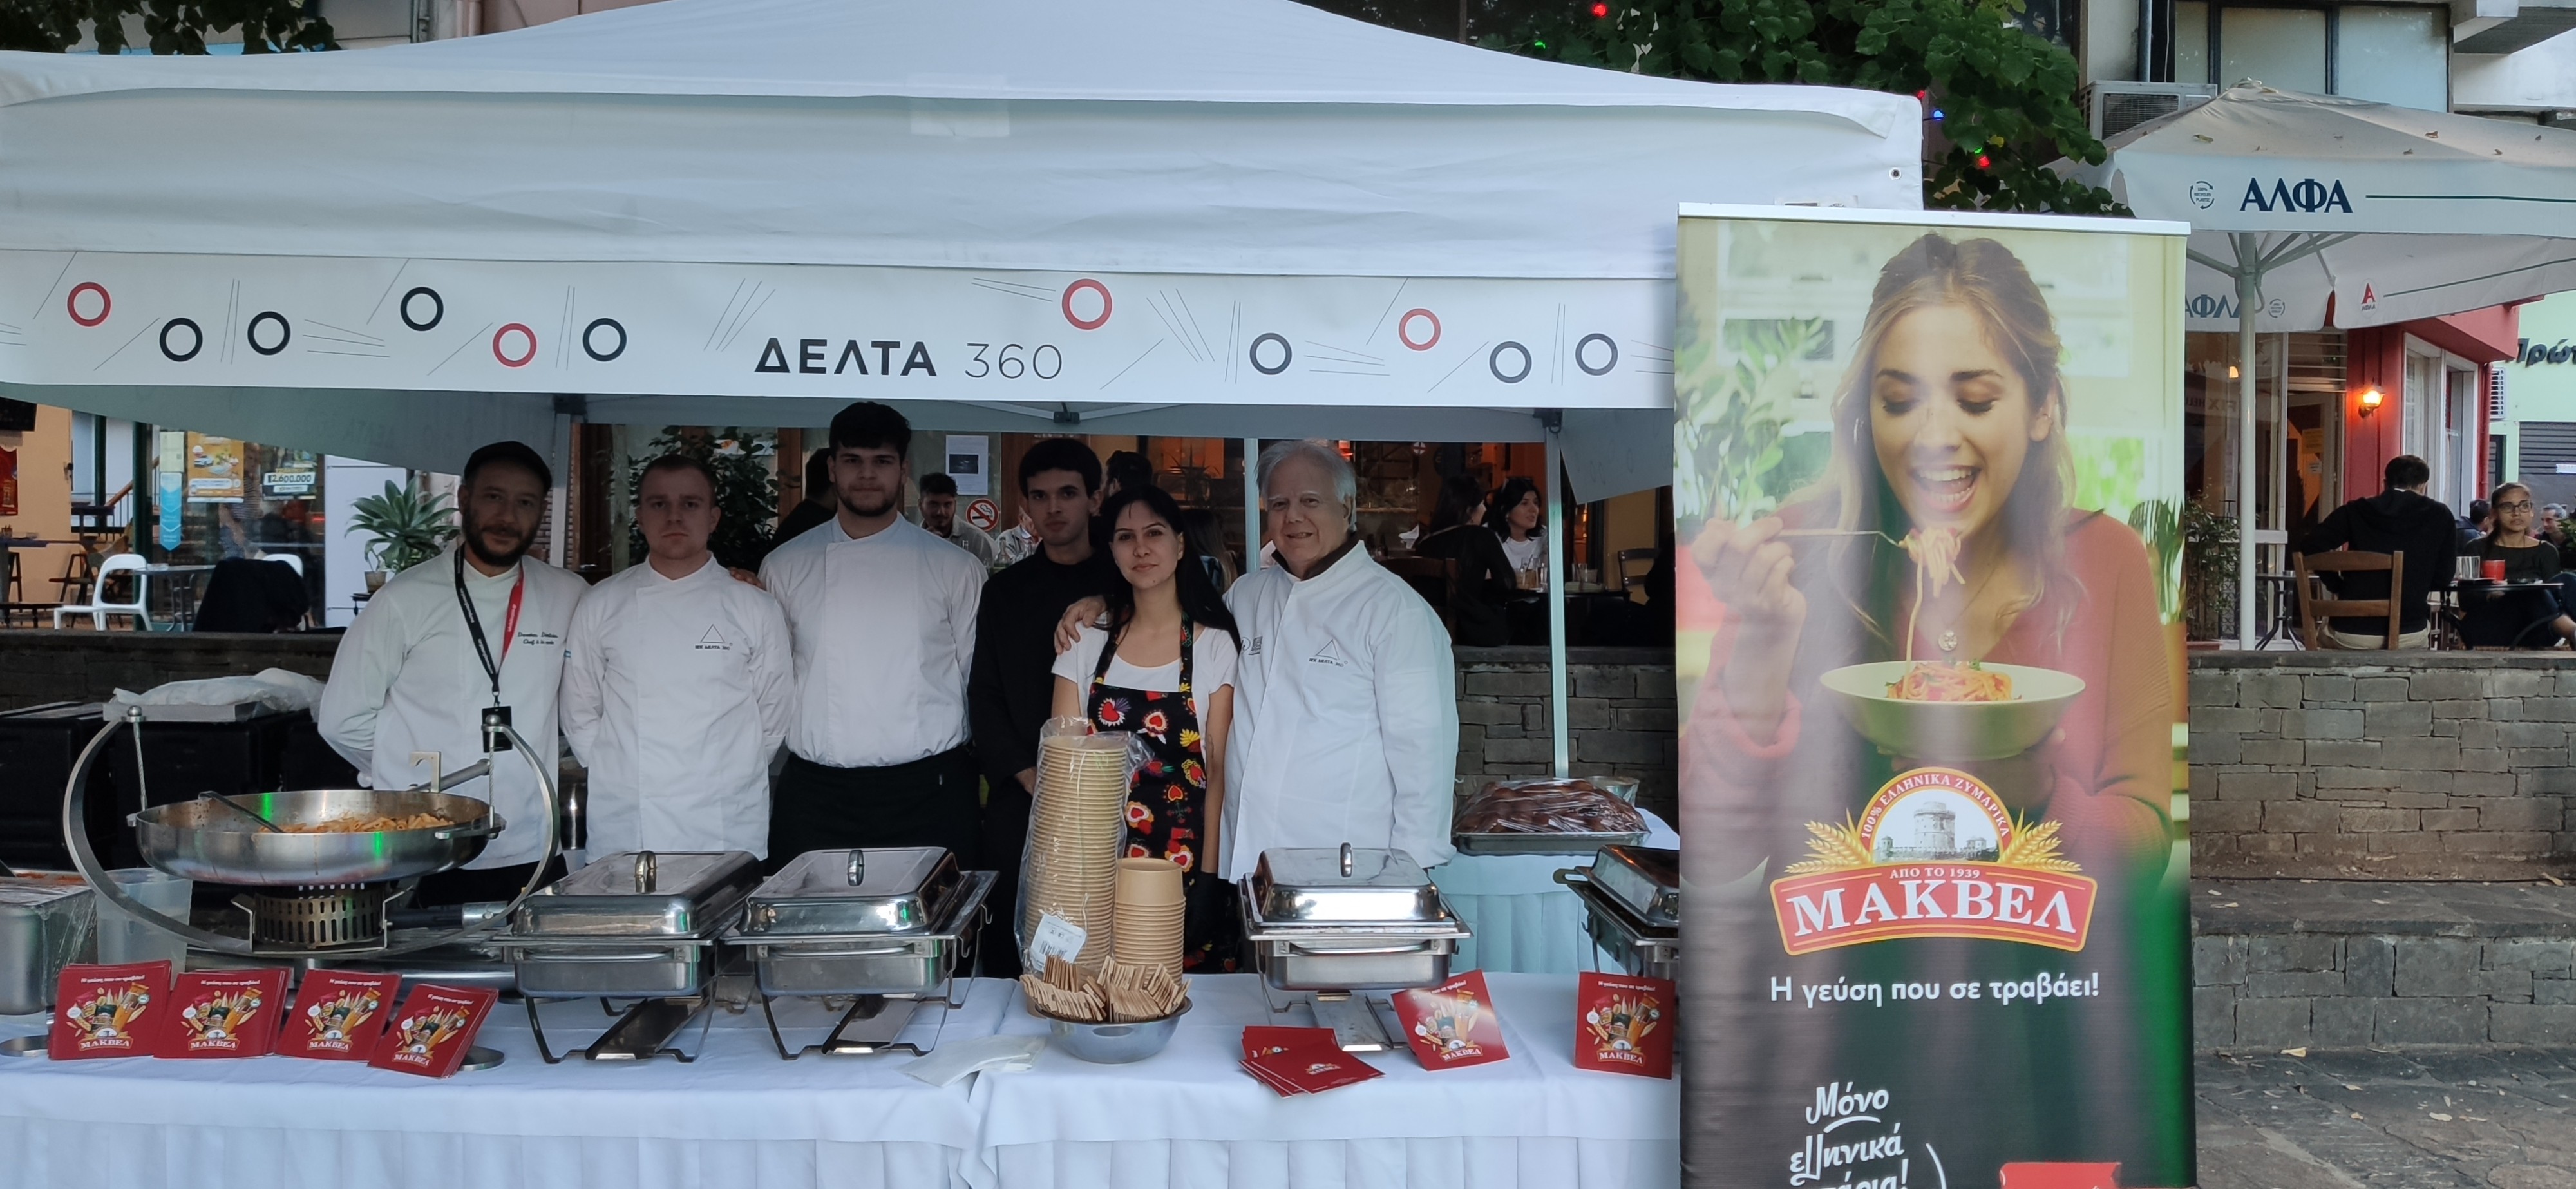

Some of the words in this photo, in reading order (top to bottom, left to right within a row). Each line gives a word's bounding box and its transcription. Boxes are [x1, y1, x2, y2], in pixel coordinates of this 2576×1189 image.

[2239, 177, 2354, 213] ΑΛΦΑ
[754, 338, 937, 377] ΔΕΛΤΑ
[965, 343, 1063, 380] 360
[1861, 807, 1882, 839] 100%
[1879, 774, 1951, 806] ΕΛΛΗΝΙΚΑ
[1953, 777, 2011, 837] ΖΥΜΑΡΙΚΑ
[1889, 868, 1920, 880] ΑΠΟ
[1924, 868, 1945, 877] ΤΟ
[1949, 868, 1981, 879] 1939
[1786, 879, 2078, 937] ΜΑΚΒΕΛ
[1770, 976, 1792, 1002] Η
[1801, 976, 1882, 1009] γεύση
[1891, 981, 1941, 1001] που
[1949, 980, 1982, 1000] σε
[1989, 971, 2099, 1005] τραβάει!
[1598, 1052, 1643, 1065] ΜΑΚΒΕΛ
[1805, 1081, 1889, 1125] Μόνο
[1790, 1122, 1906, 1186] ελληνικά
